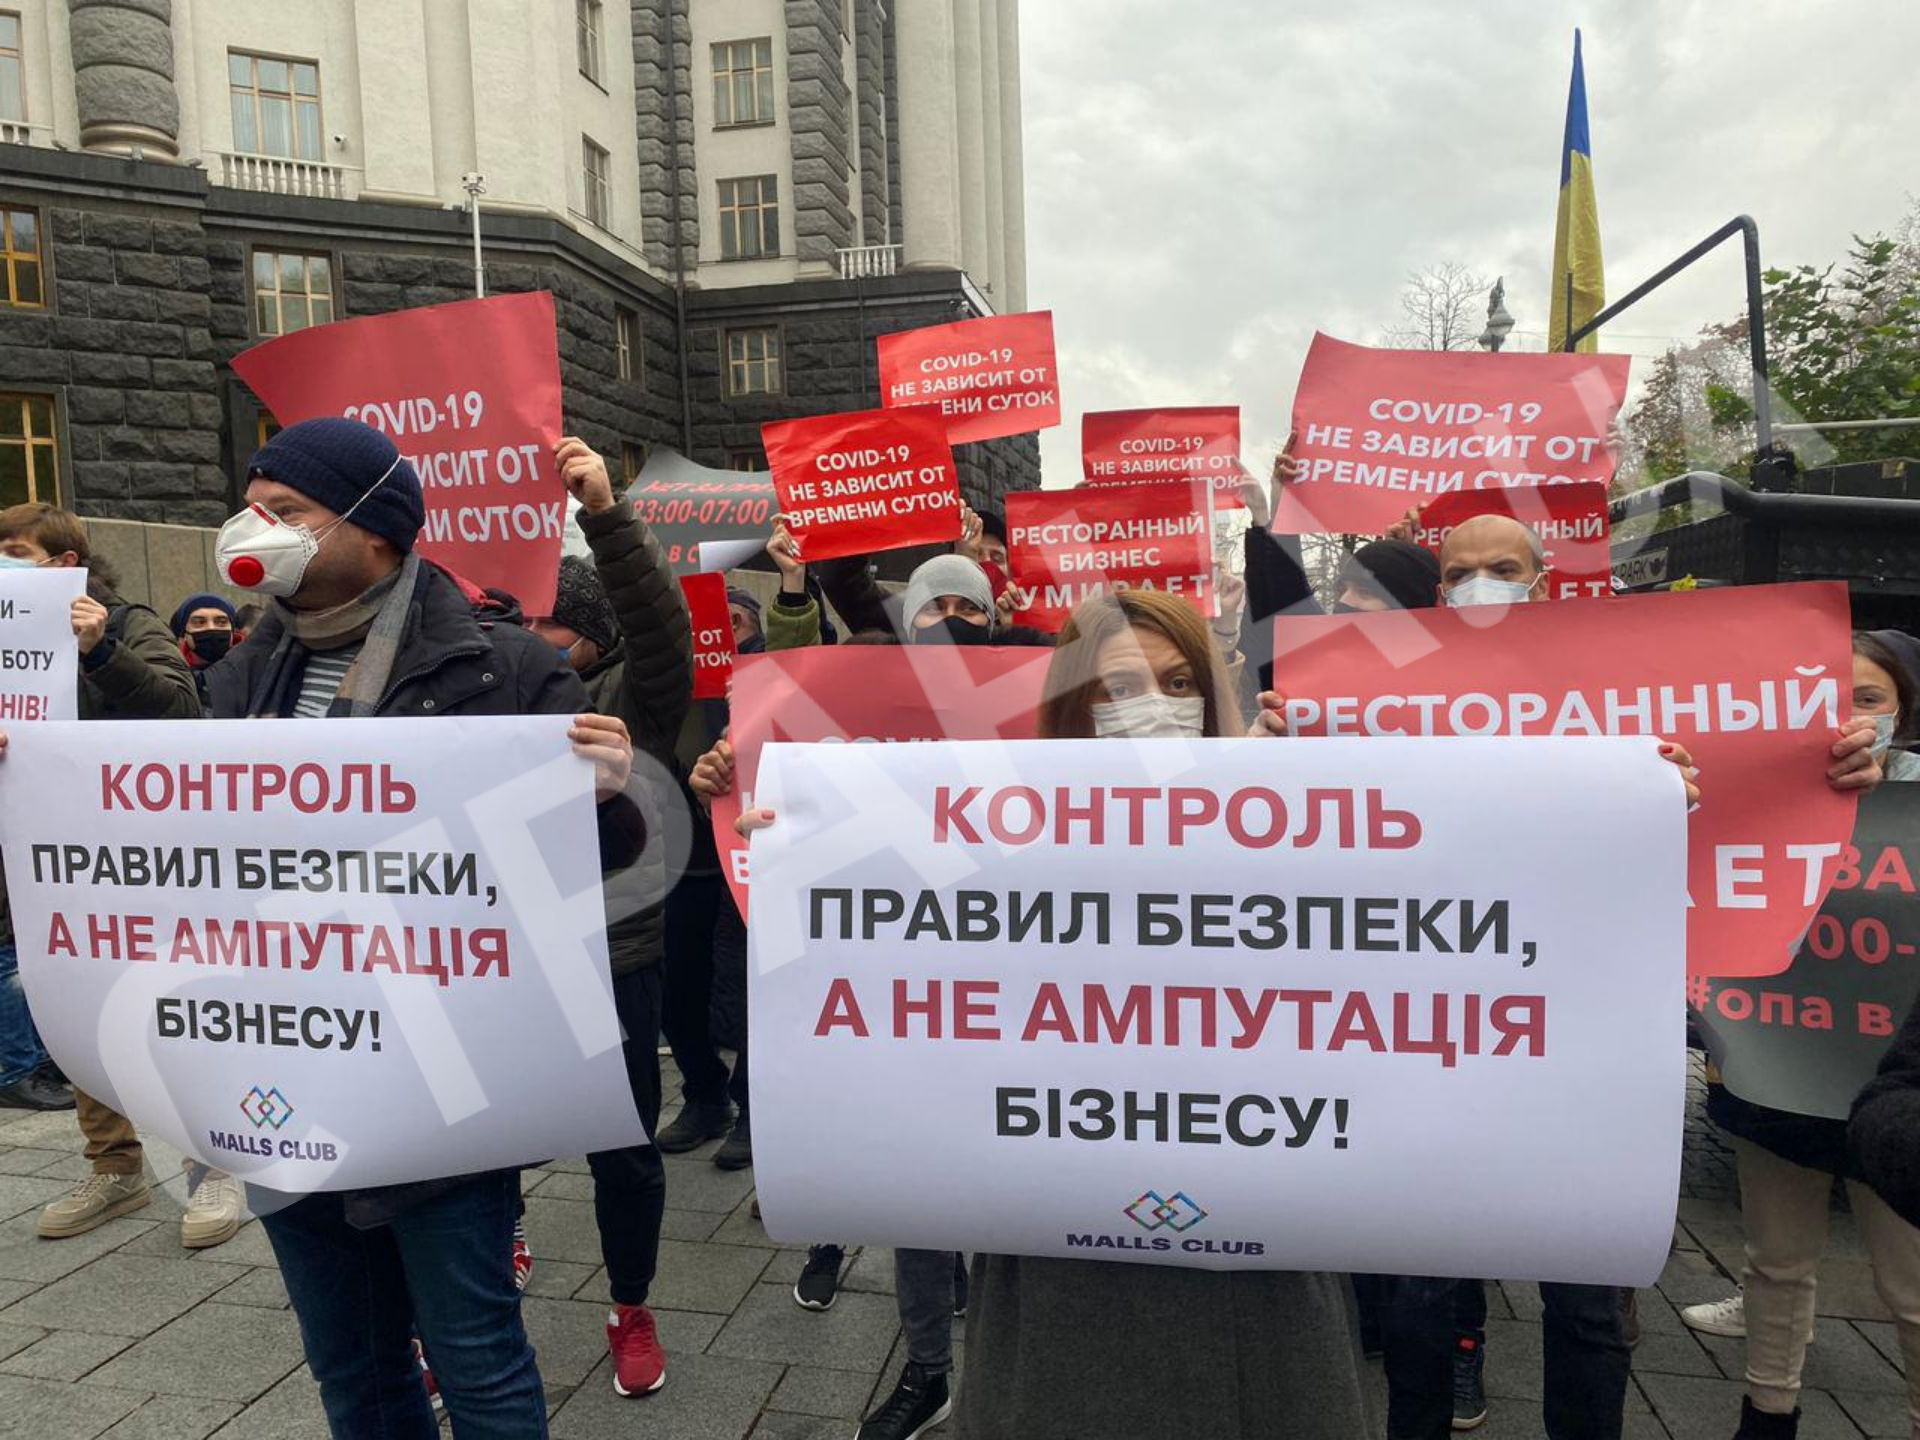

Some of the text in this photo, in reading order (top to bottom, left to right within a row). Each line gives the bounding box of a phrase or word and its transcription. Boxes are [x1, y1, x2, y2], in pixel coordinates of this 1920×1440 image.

[920, 348, 1013, 373] COVID-19
[891, 368, 1046, 398] НЕ ЗАВИСИТ ОТ
[988, 390, 1055, 410] СУТОК
[1369, 398, 1542, 425] COVID-19
[816, 445, 910, 472] COVID-19
[1119, 437, 1204, 454] COVID-19
[1306, 424, 1599, 463] НЕ ЗАВИСИТ ОТ
[411, 444, 540, 488] ИСИТ ОТ
[1092, 456, 1232, 475] НЕ ЗАВИСИТ ОТ
[1474, 470, 1605, 492] СУТ
[789, 482, 818, 502] НЕ
[821, 470, 914, 498] ЗАВИСИТ
[919, 466, 945, 484] ОТ
[458, 502, 561, 542] СУТОК
[789, 489, 957, 528] ВРЕМЕНИ СУТОК
[1011, 511, 1206, 546] РЕСТОРАННЫЙ
[1059, 547, 1161, 573] БИЗНЕС
[700, 629, 722, 646] ОТ
[1285, 664, 1840, 738] РЕСТОРАННЫЙ
[101, 763, 417, 814] КОНТРОЛЬ
[932, 785, 1423, 850] КОНТРОЛЬ
[32, 844, 498, 907] ПРАВИЛ БЕЗПЕКИ,
[808, 888, 1538, 967] ПРАВИЛ БЕЗПЕКИ,
[47, 912, 510, 986] А НЕ АМПУТАЦІЯ
[155, 997, 382, 1053] БІЗНЕСУ!
[813, 977, 1547, 1068] А НЕ АМПУТАЦІЯ
[995, 1086, 1350, 1149] БІЗНЕСУ!
[209, 1130, 339, 1162] MALLS CLUB
[1066, 1233, 1265, 1255] MALLS CLUB
